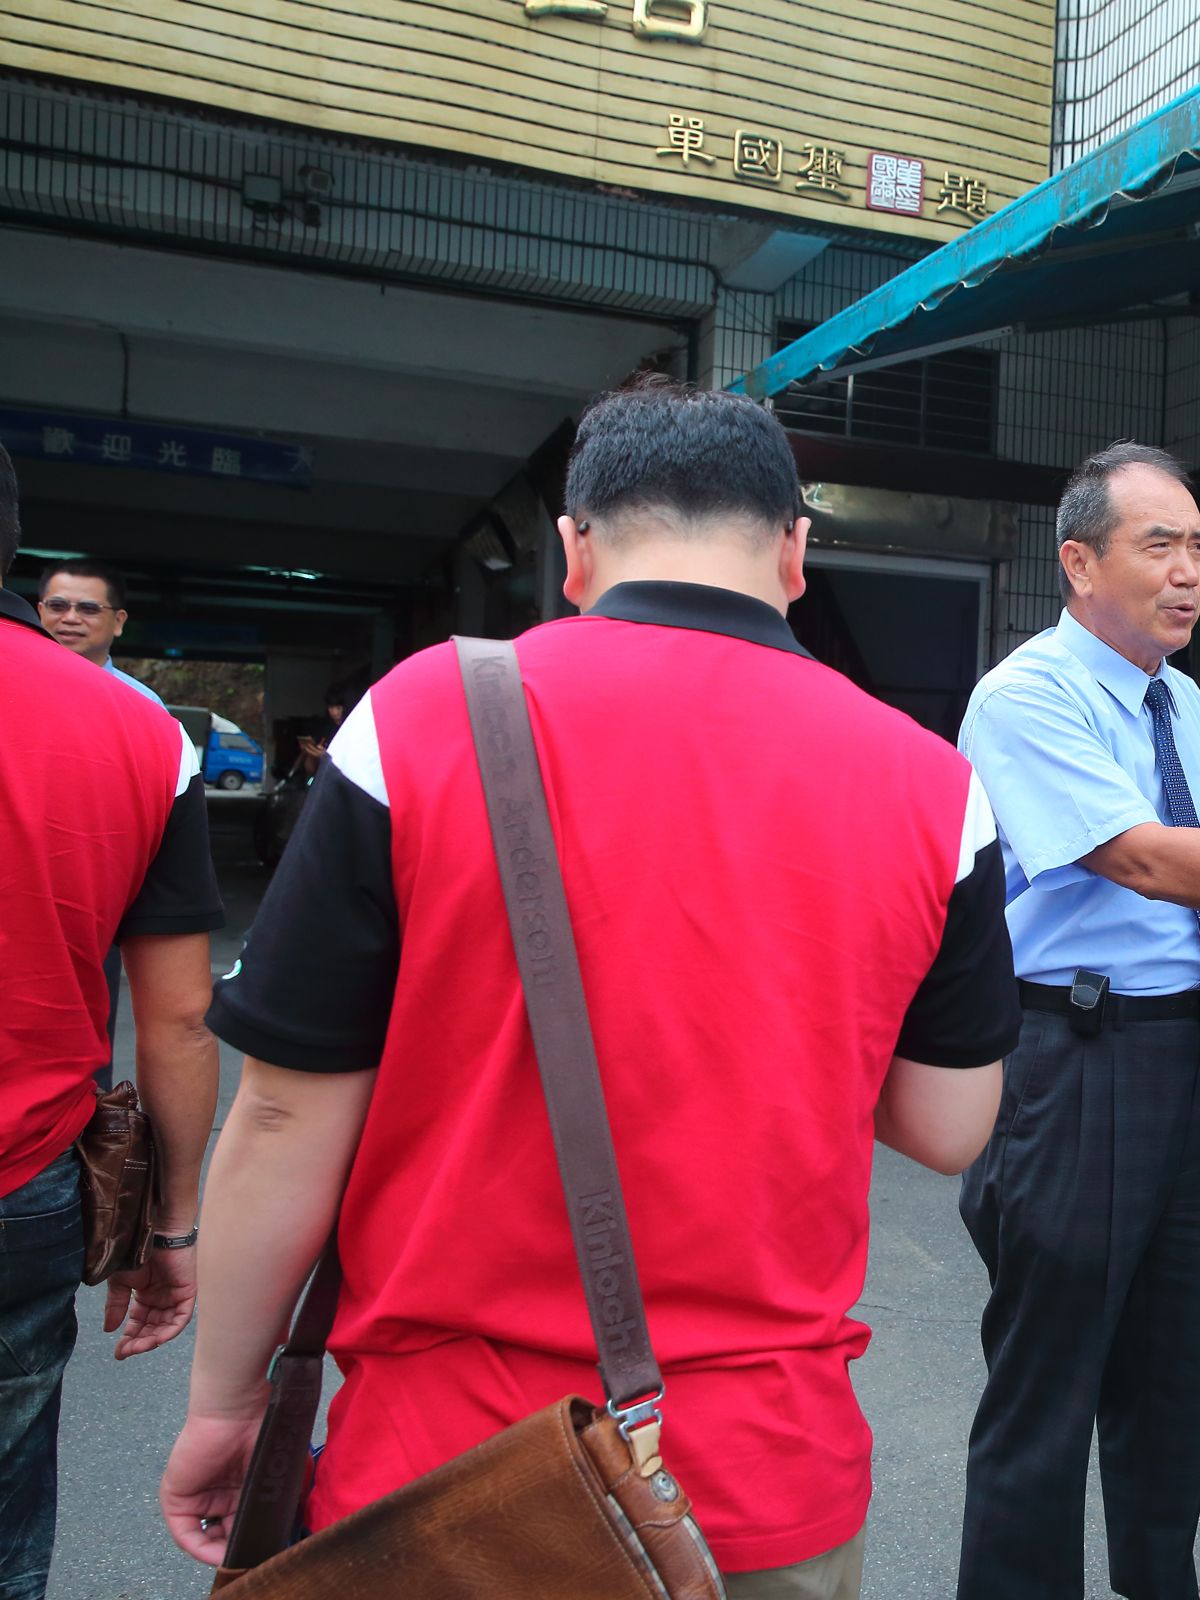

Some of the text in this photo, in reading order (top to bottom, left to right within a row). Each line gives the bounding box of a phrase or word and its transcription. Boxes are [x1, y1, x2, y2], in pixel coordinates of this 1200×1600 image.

[42, 426, 242, 476] 歡迎光臨
[471, 655, 518, 783] Kinloch
[578, 1189, 637, 1352] Kinloch
